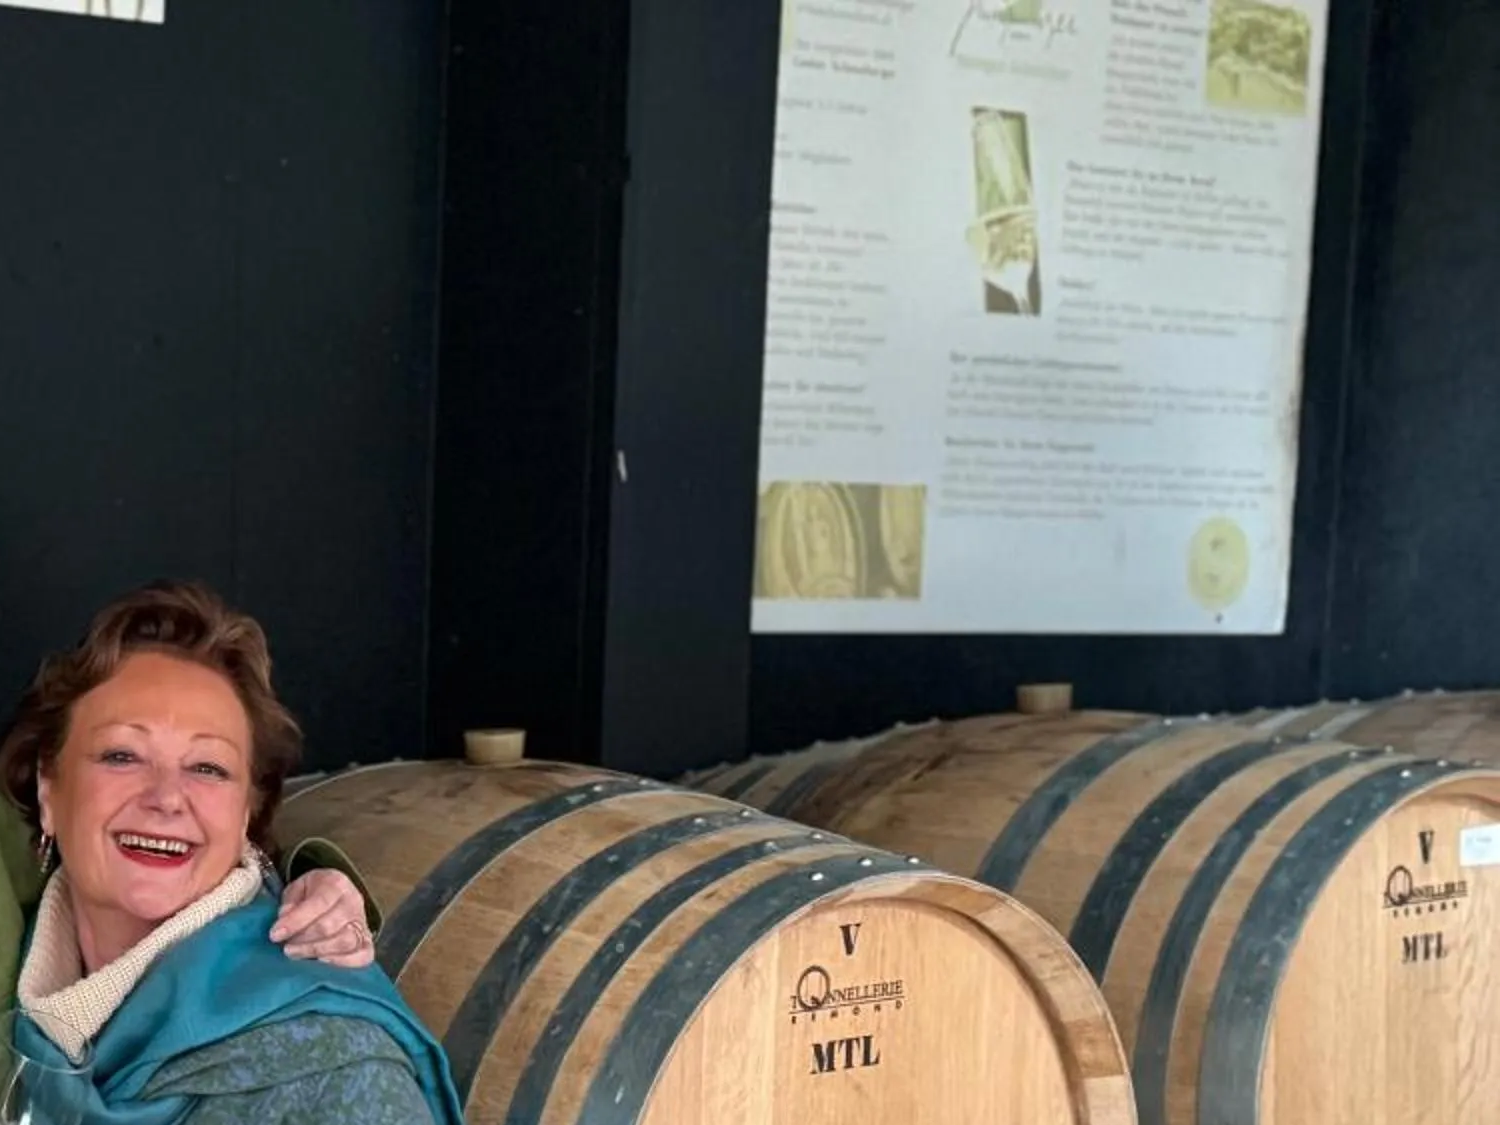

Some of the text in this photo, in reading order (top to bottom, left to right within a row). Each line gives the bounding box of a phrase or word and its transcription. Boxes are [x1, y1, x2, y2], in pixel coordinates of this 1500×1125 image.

[1418, 829, 1435, 865] V
[839, 923, 862, 957] V
[1402, 930, 1449, 964] MTL
[809, 1035, 881, 1075] MTL
